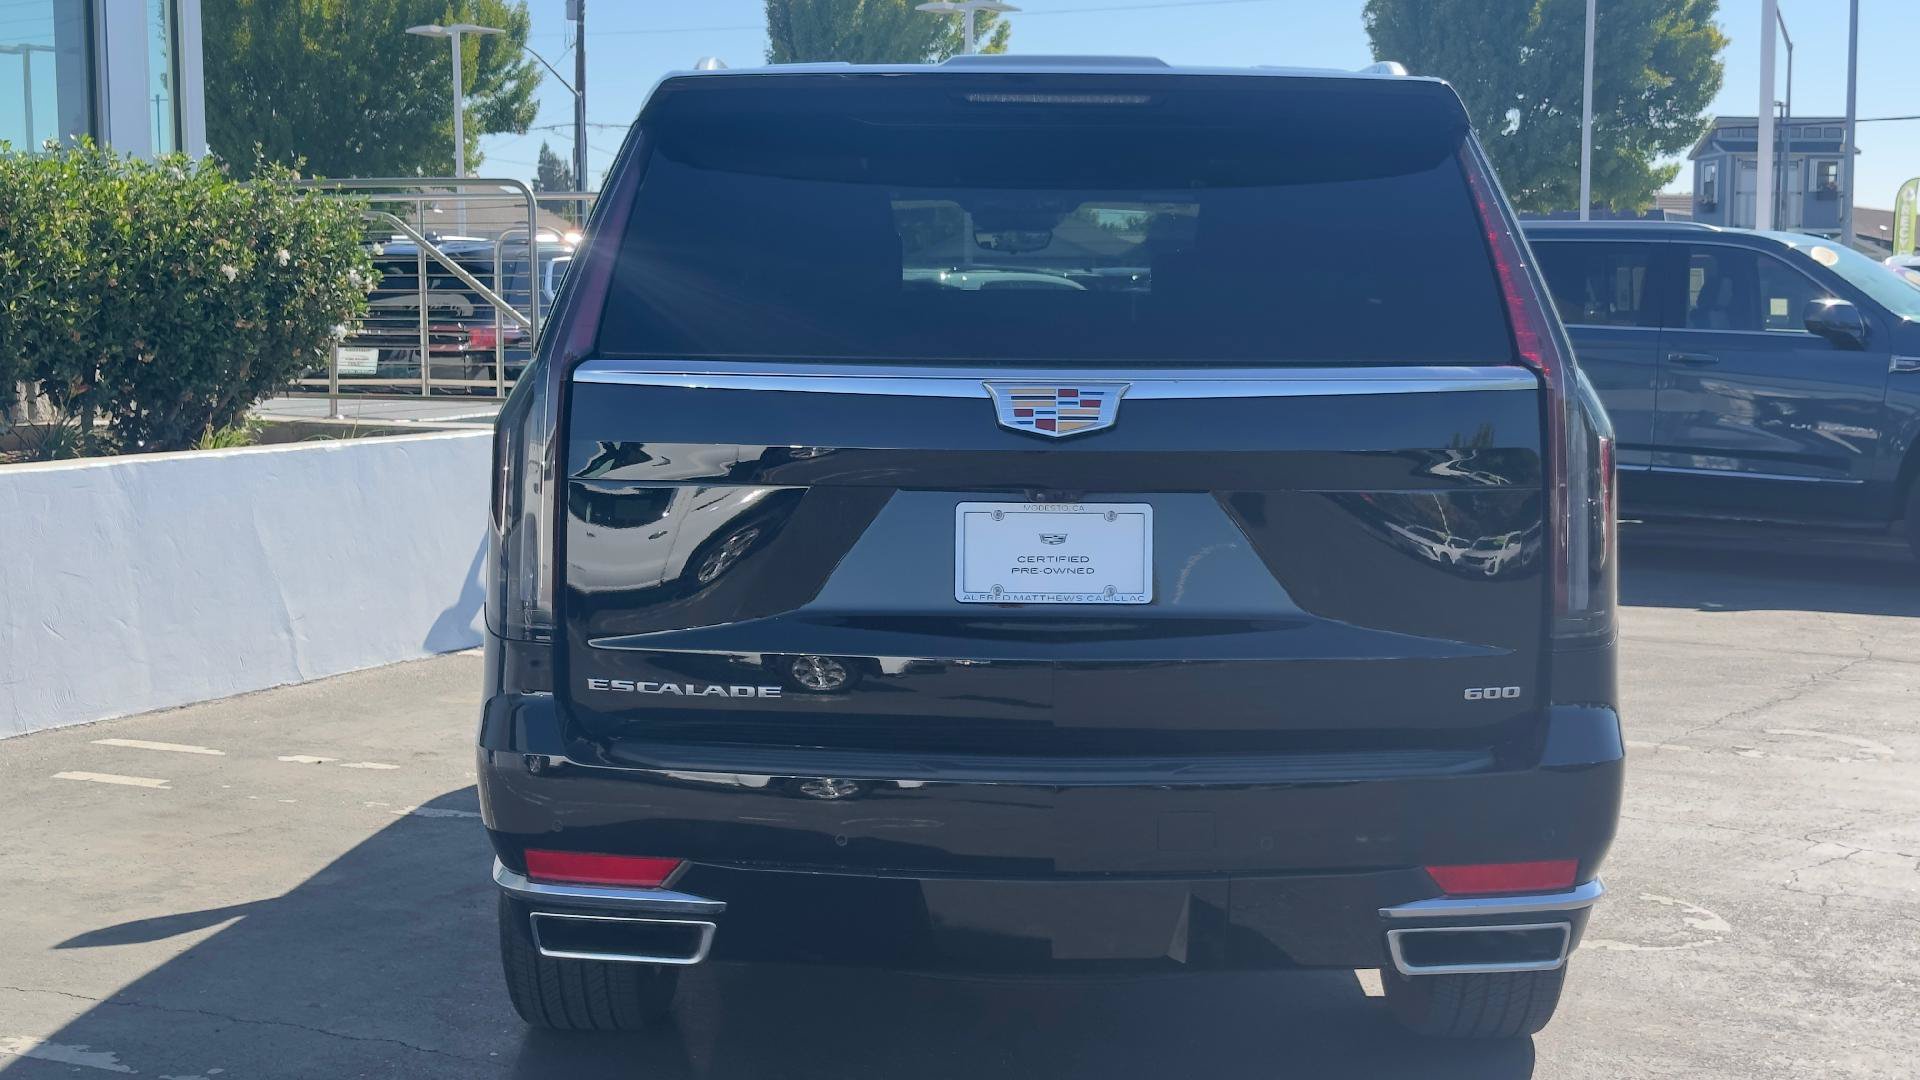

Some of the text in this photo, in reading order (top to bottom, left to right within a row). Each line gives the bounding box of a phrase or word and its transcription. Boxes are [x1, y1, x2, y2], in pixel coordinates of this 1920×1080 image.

[1017, 555, 1090, 563] CERTIFIED
[1011, 567, 1095, 575] PRE-OWNED
[963, 594, 1145, 602] ALFRED MATTHEWS CADILLAC
[587, 678, 782, 698] ESCALADE
[1464, 686, 1520, 700] 600
